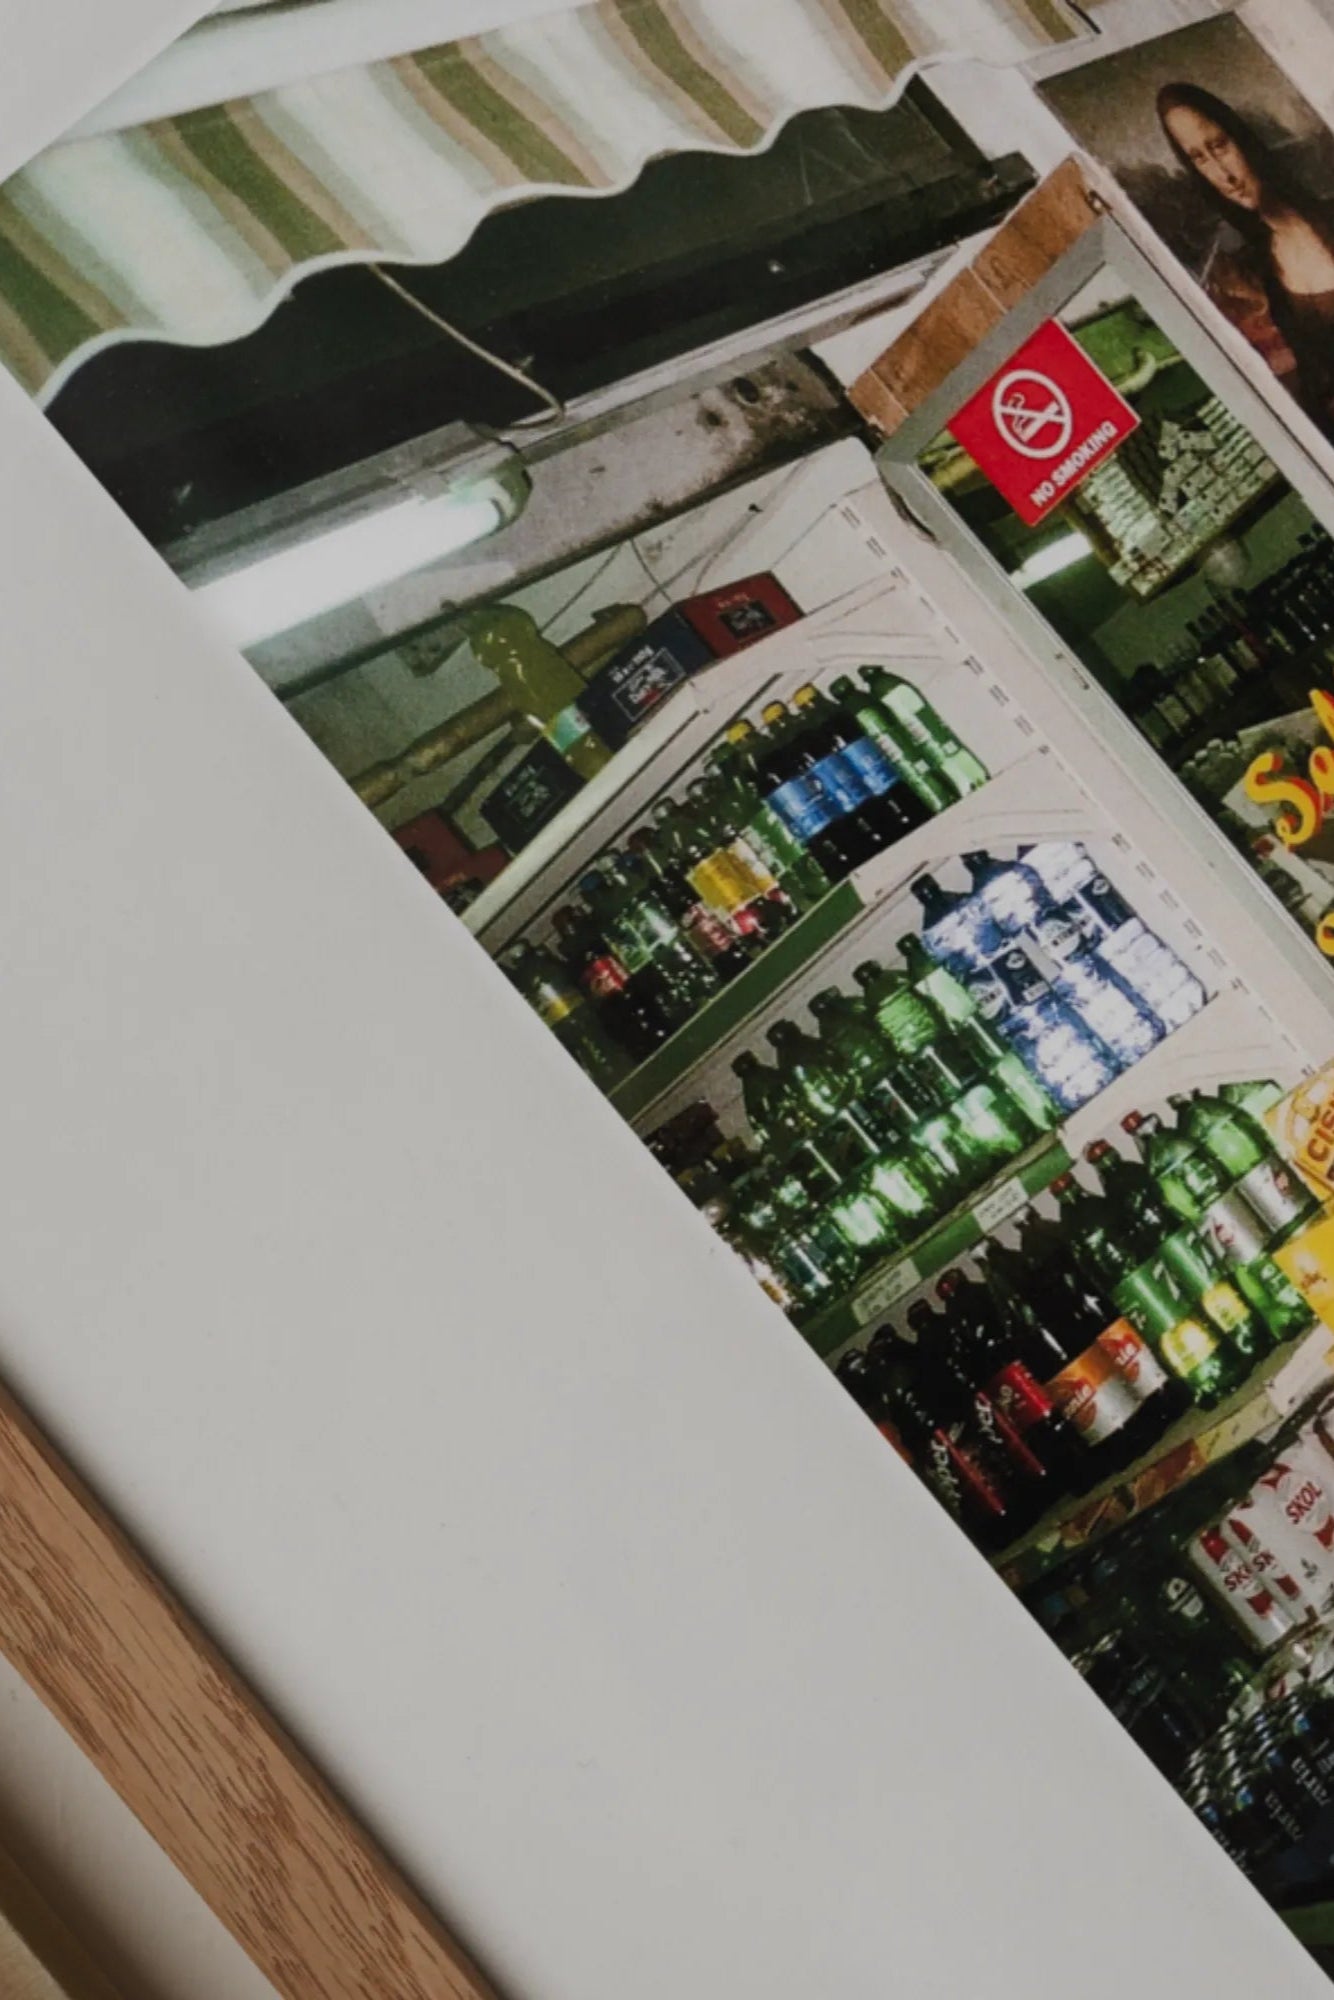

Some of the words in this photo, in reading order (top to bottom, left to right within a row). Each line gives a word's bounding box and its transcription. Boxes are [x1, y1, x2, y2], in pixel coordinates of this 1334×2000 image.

[1030, 481, 1055, 508] NO
[1050, 420, 1119, 488] SMOKING
[1285, 1480, 1323, 1525] SKOL
